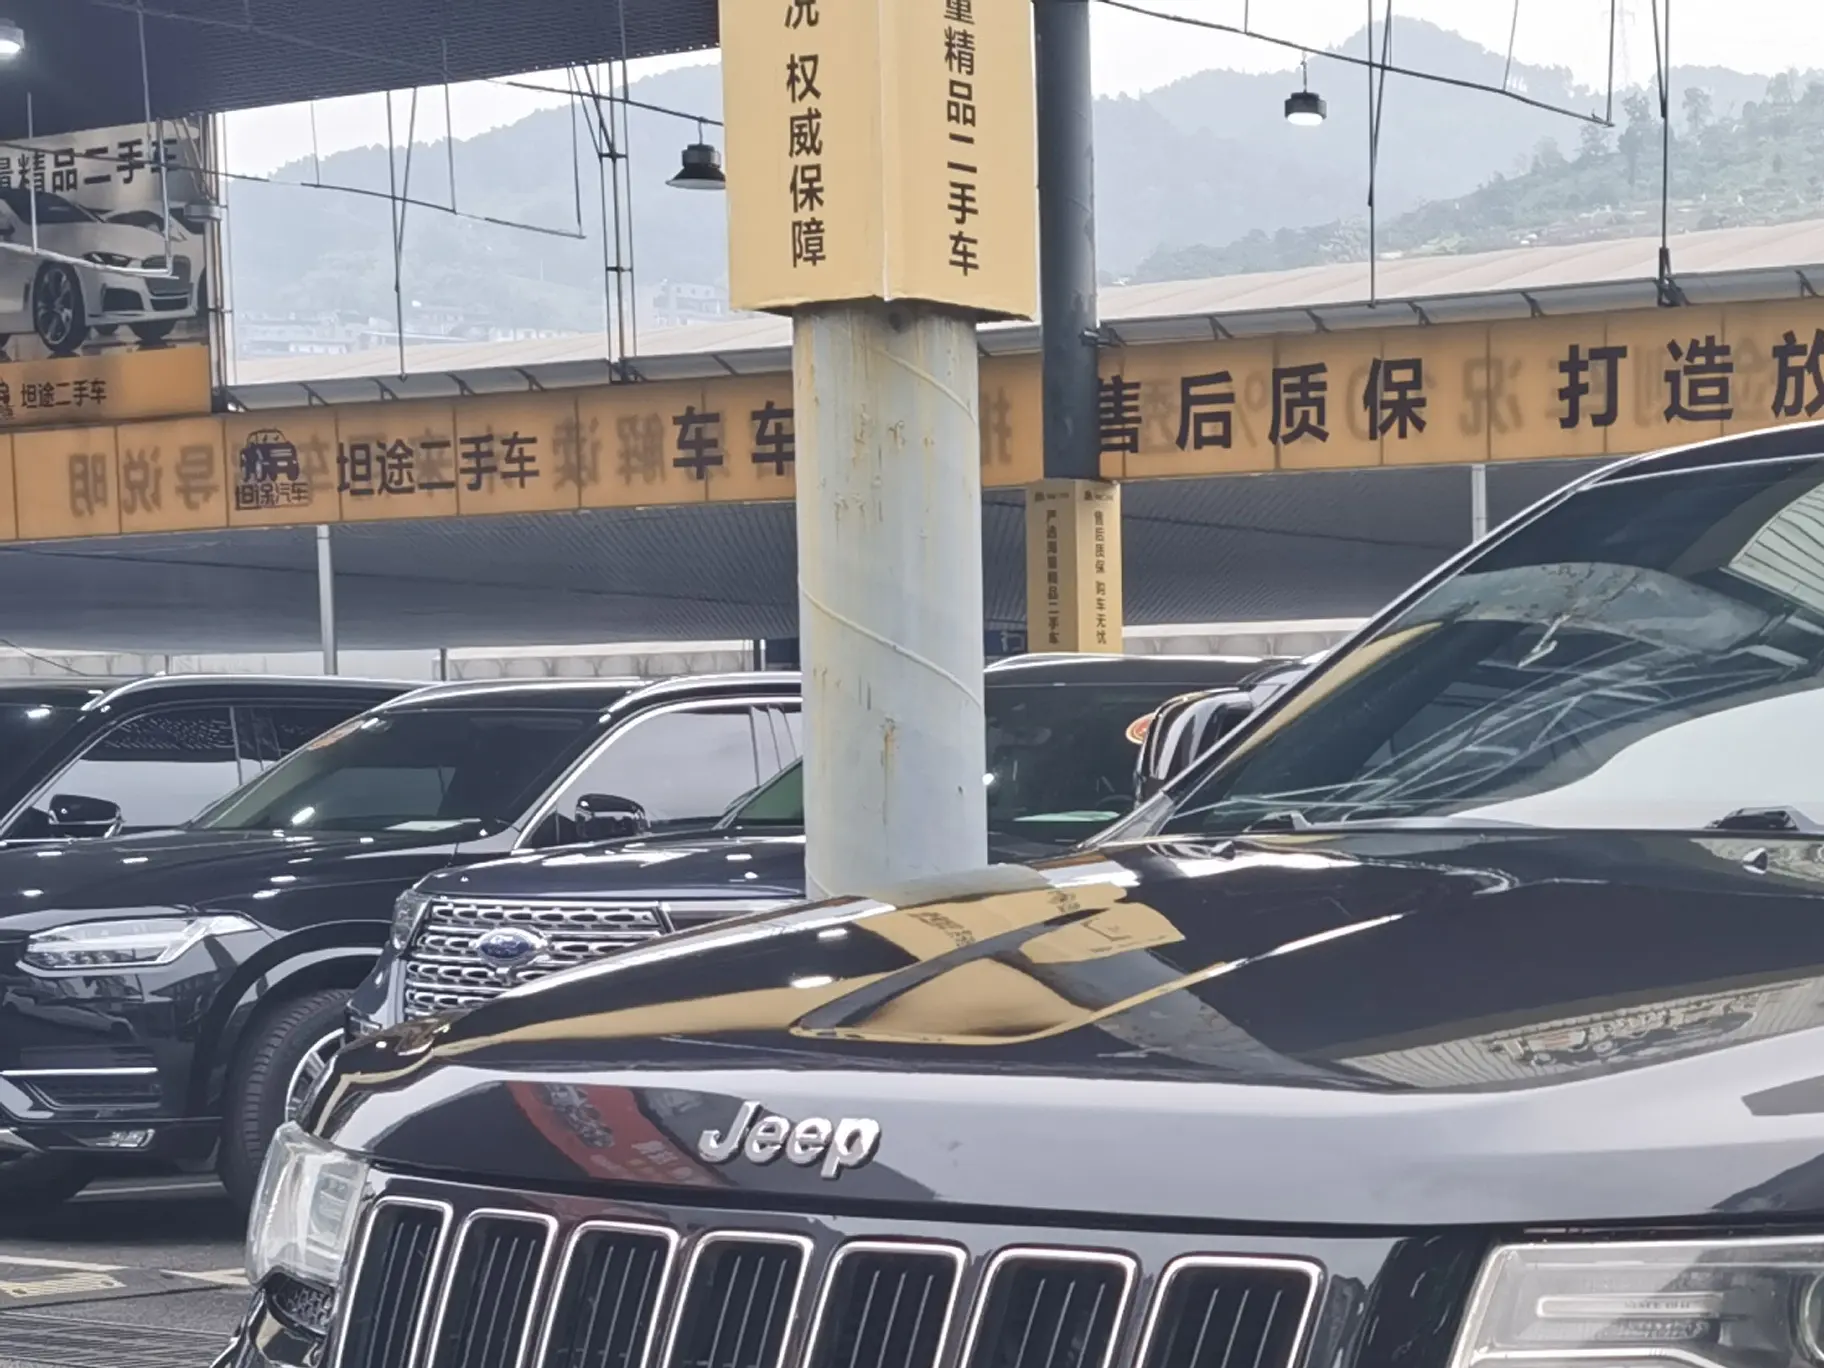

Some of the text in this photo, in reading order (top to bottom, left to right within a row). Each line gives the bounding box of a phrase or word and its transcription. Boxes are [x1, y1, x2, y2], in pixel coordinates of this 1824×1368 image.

[786, 53, 826, 268] 权威保障
[337, 431, 540, 496] 坦途二手车
[1098, 357, 1427, 455] 售后质保
[698, 1101, 881, 1180] Jeep
